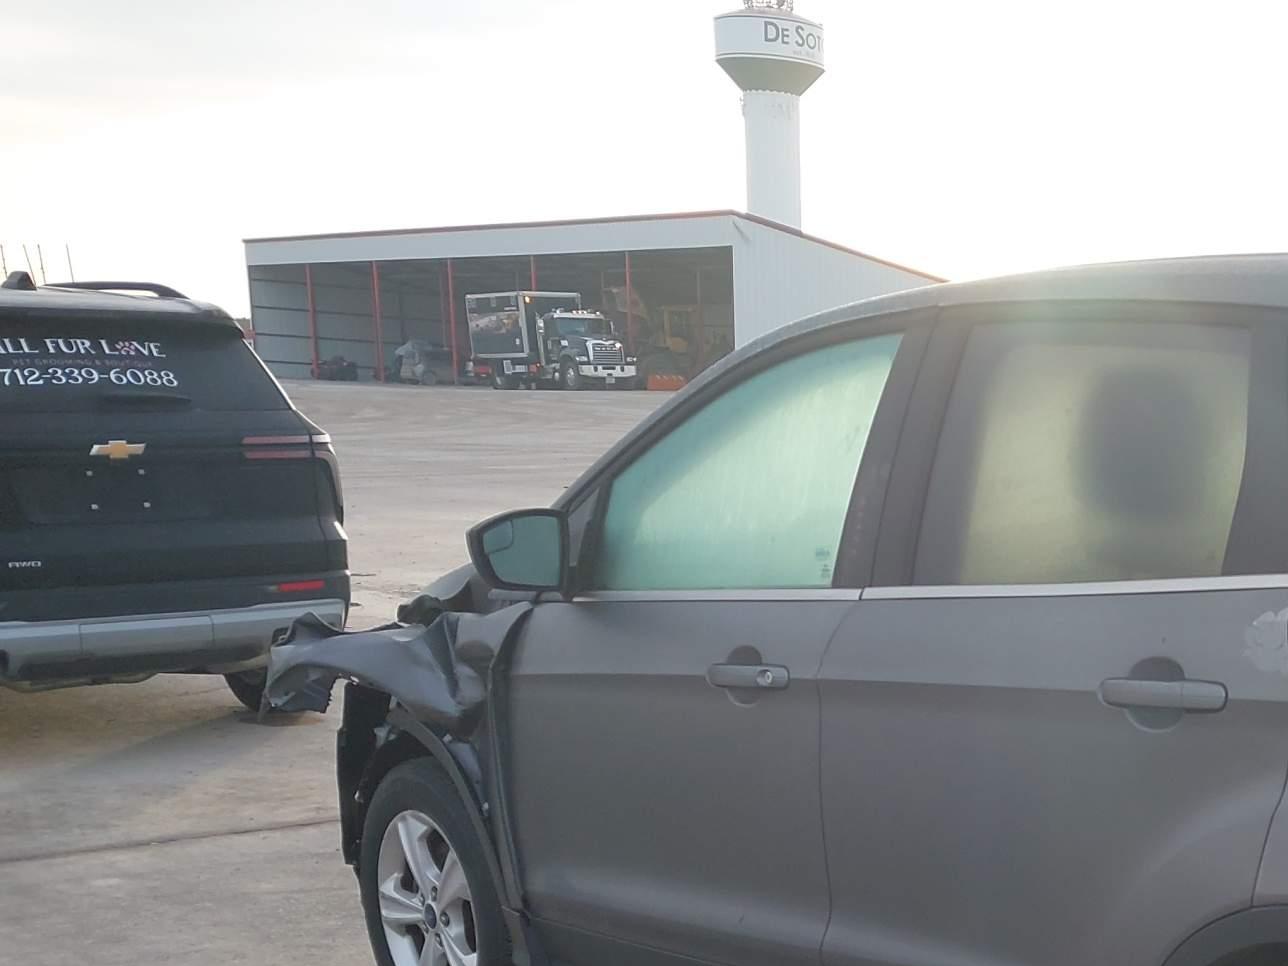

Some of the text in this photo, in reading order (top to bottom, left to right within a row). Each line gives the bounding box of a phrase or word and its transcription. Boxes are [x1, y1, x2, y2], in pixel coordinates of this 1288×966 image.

[44, 338, 96, 355] FUR
[0, 367, 178, 387] 712-339-6088
[8, 560, 42, 569] AWD
